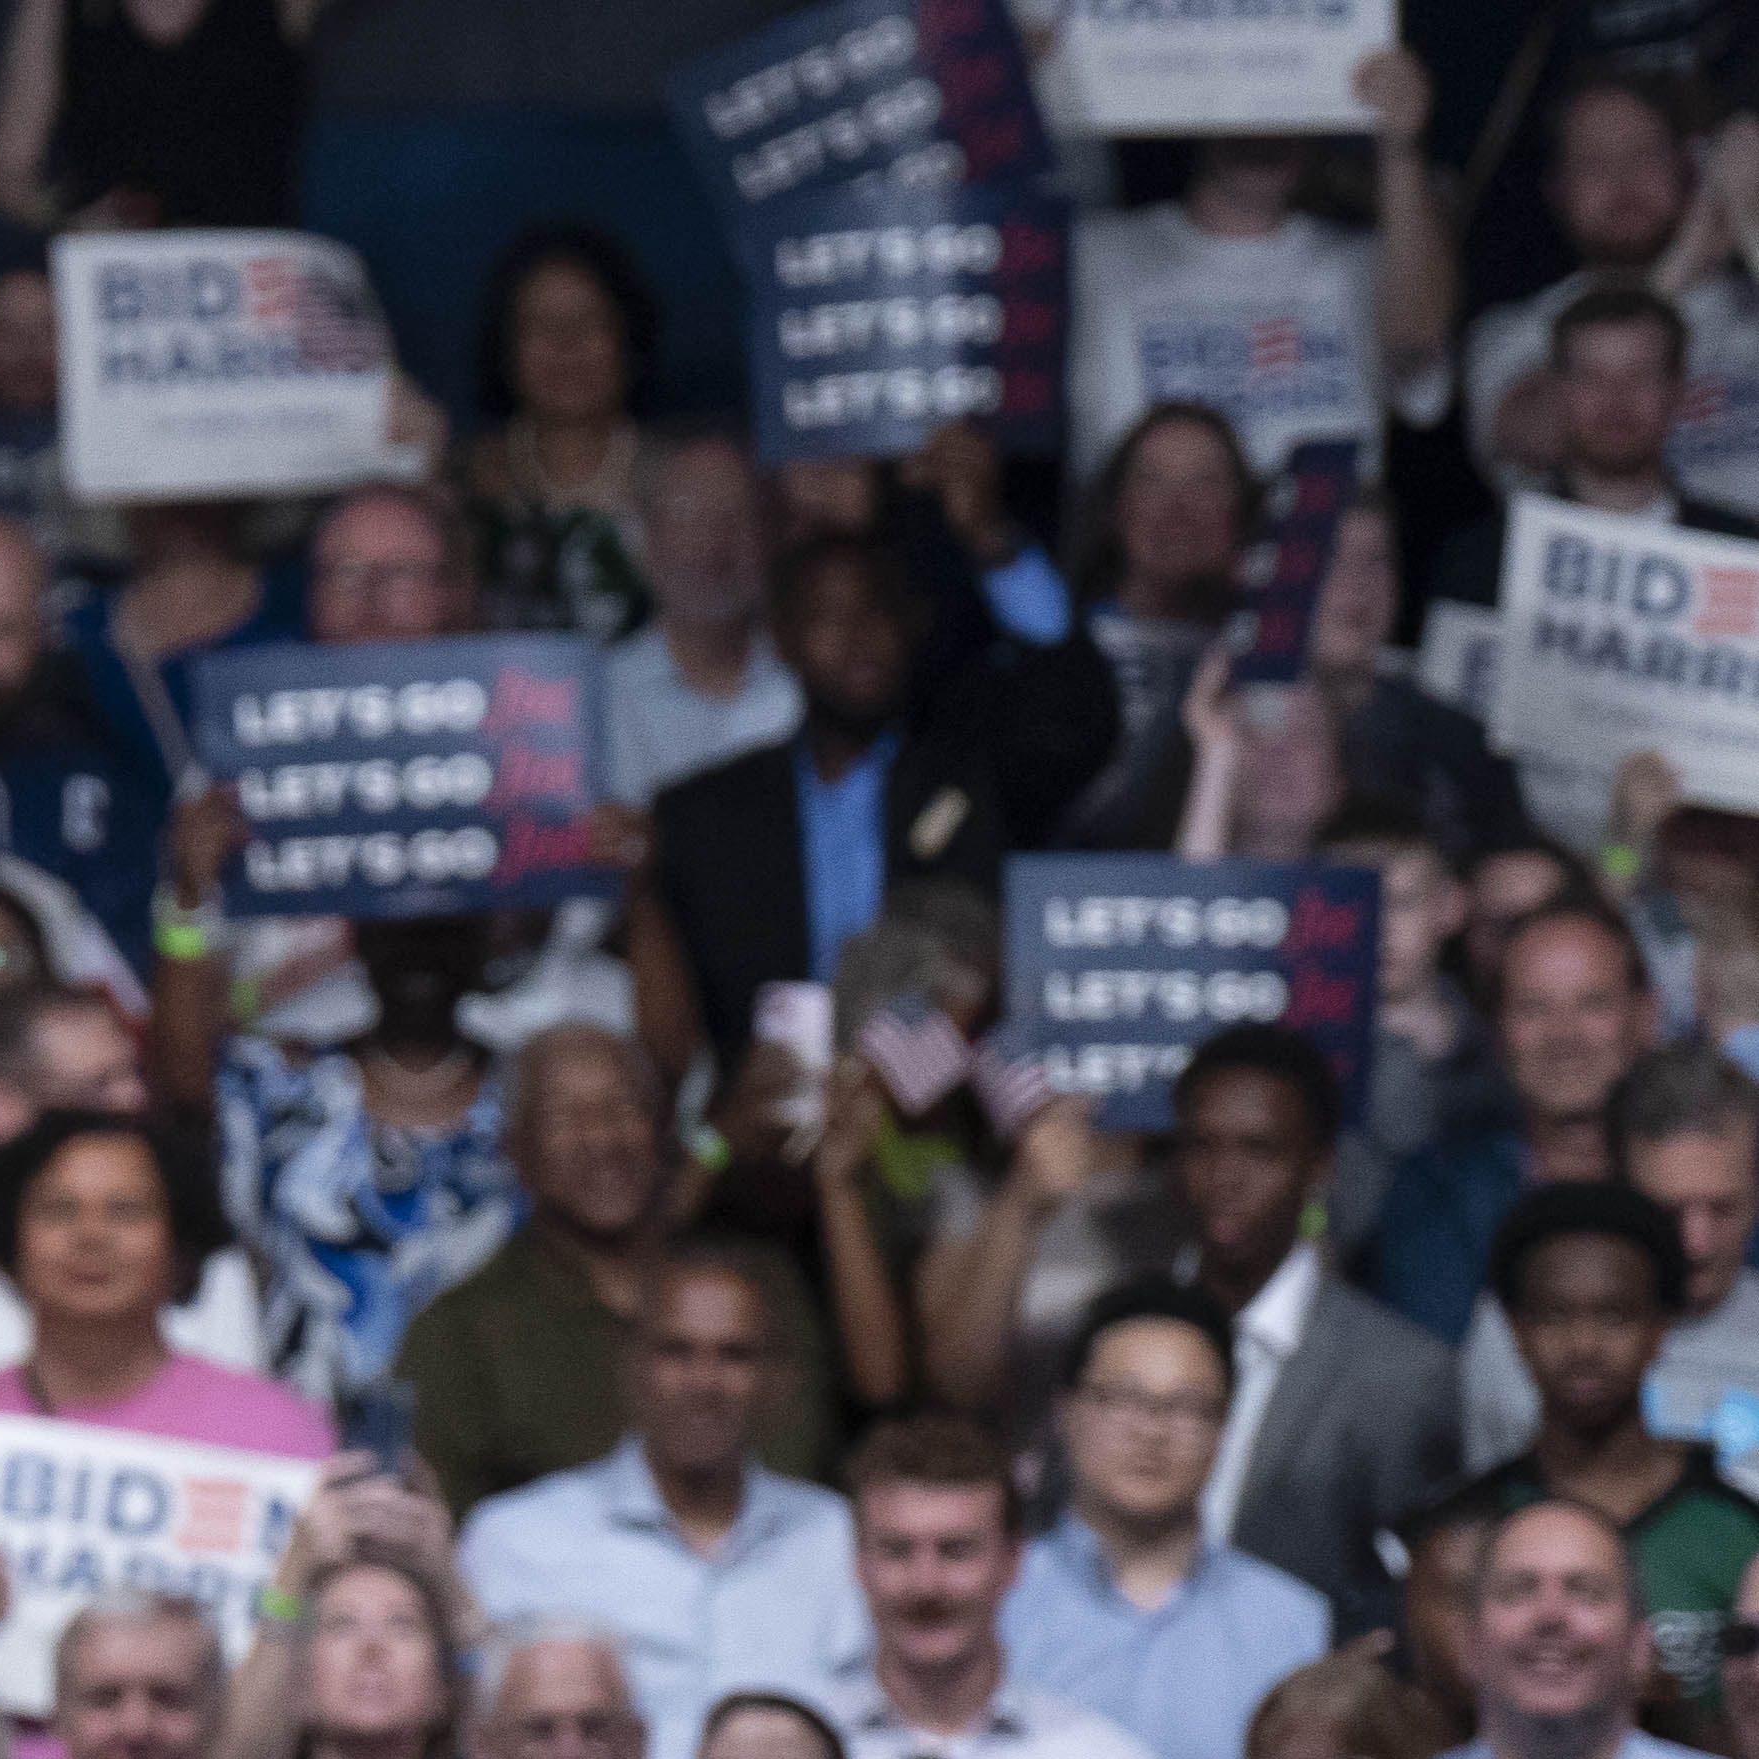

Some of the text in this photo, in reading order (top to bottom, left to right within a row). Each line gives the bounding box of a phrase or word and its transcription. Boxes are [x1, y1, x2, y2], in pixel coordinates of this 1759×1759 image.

[1543, 530, 1759, 637] BIDE
[231, 683, 402, 750] LET'S
[399, 677, 489, 735] GO
[237, 756, 405, 822] LET'S
[404, 751, 496, 810] GO
[242, 830, 410, 896] LET'S
[408, 825, 501, 883] GO
[1043, 896, 1200, 949] LET'S
[1202, 896, 1291, 949] GO
[1042, 970, 1203, 1024] LET'S
[1204, 970, 1293, 1024] GO
